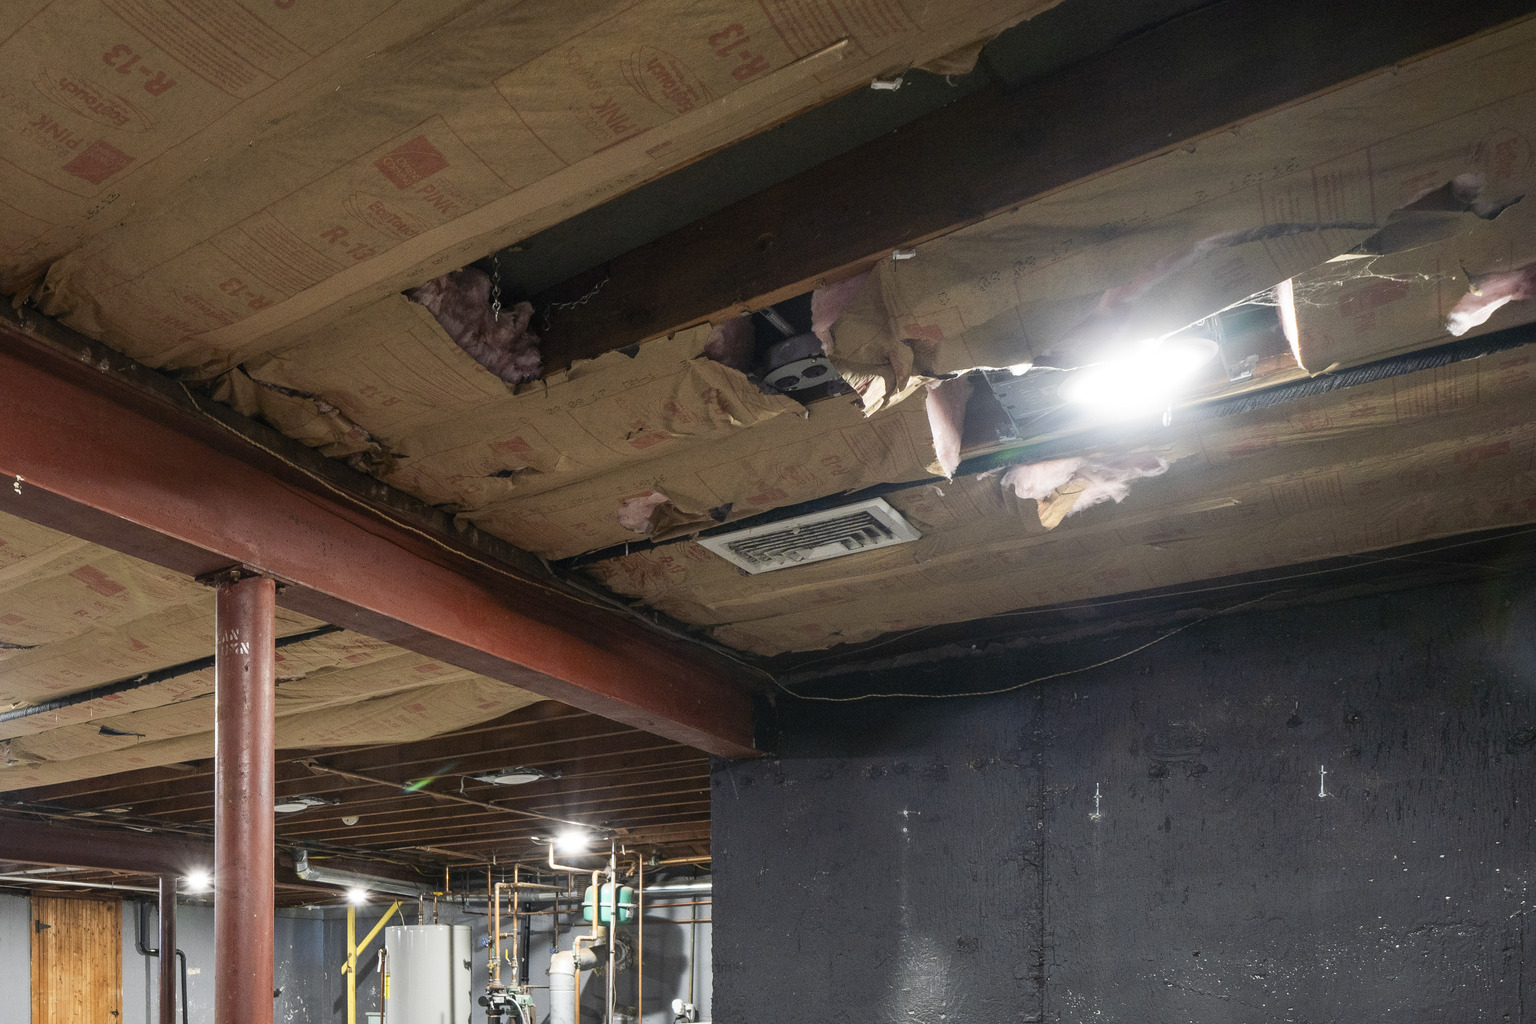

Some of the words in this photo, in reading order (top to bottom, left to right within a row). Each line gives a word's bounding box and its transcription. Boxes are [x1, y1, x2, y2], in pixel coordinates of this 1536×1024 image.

[102, 43, 178, 98] R-13
[707, 22, 771, 82] R-13
[30, 114, 85, 150] PINK
[589, 97, 637, 136] PINK
[415, 184, 459, 215] PINK
[319, 224, 377, 261] R-13
[218, 276, 273, 310] R-13
